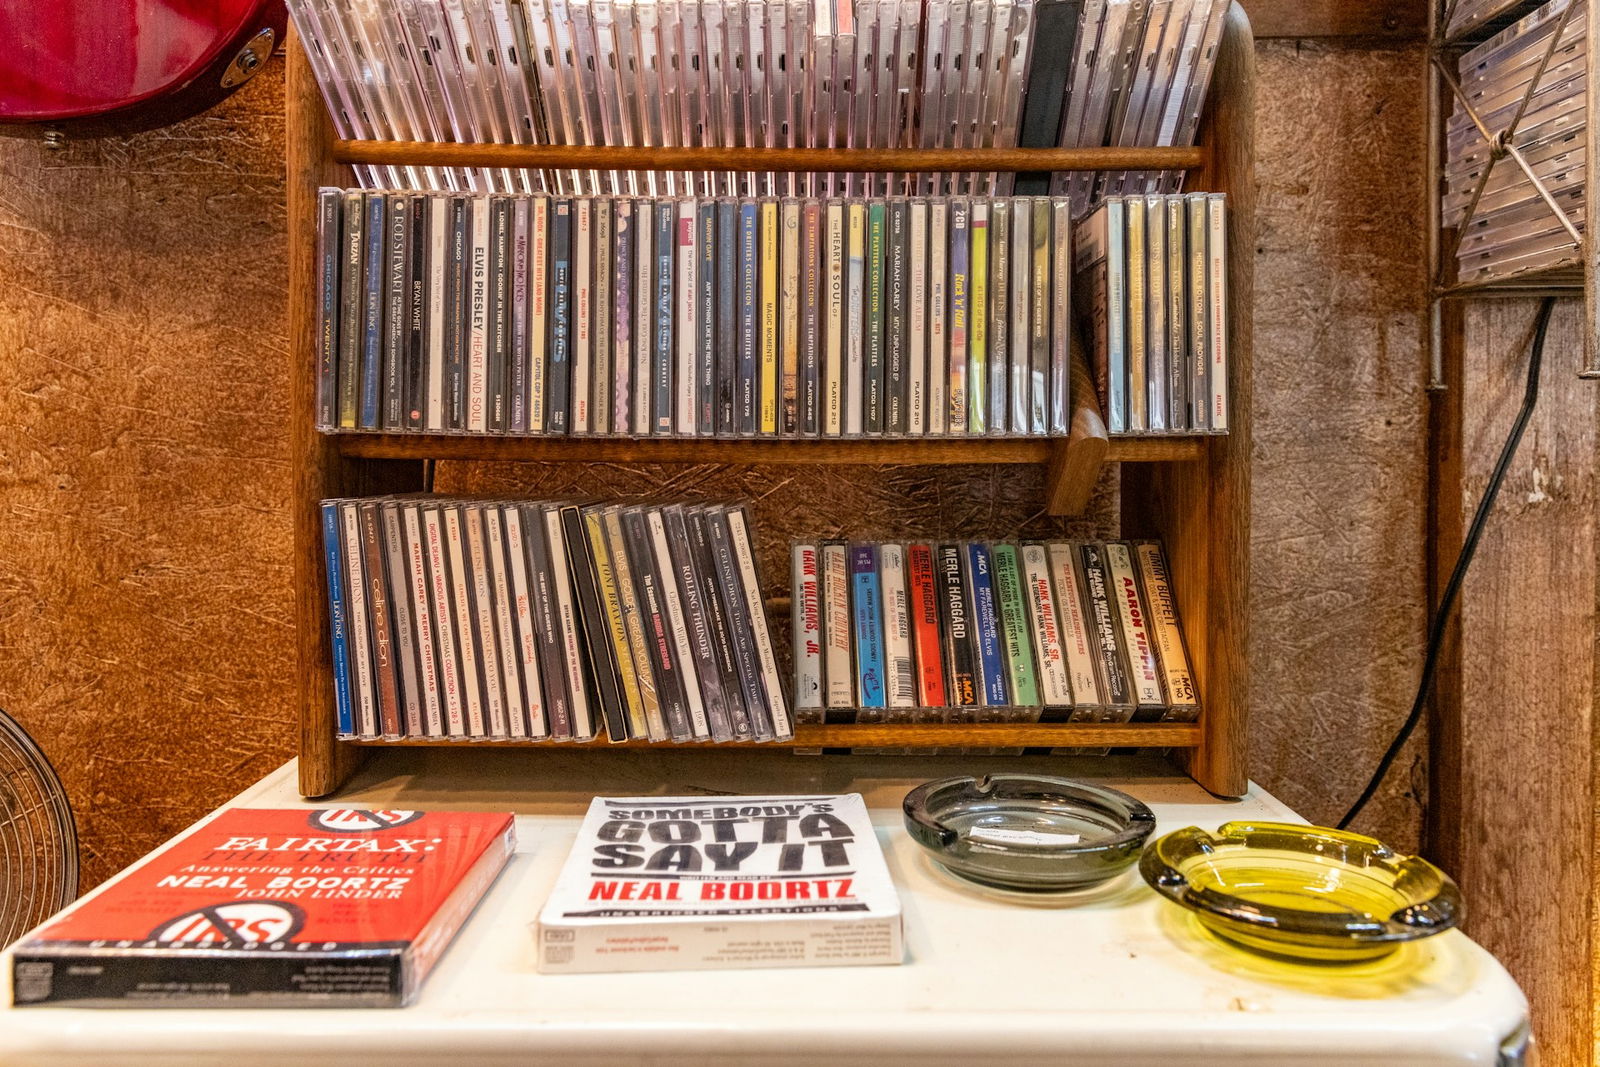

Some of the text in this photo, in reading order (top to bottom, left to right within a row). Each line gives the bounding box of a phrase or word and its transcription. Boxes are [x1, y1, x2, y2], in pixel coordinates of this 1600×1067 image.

[955, 210, 964, 228] 2CD
[350, 231, 360, 264] TARZAN
[393, 217, 404, 293] ROD STEWART
[413, 281, 421, 305] BRYAN
[832, 275, 840, 307] SOUL
[955, 274, 964, 295] Rock
[955, 310, 963, 328] Roll
[472, 247, 484, 424] ELVIS PRESLEY/HEART AND SOUL
[389, 516, 398, 552] CARPENTERS
[429, 523, 438, 545] DIGITAL
[349, 538, 359, 576] CELINE
[413, 543, 421, 575] MARIAH
[802, 550, 815, 575] HANK
[832, 552, 844, 574] HARD
[978, 555, 986, 575] MCA
[352, 577, 362, 604] DION
[416, 578, 425, 604] CAREY
[435, 575, 444, 600] VARIOUS
[644, 574, 652, 585] The
[719, 549, 737, 607] CELINE DION
[919, 550, 934, 624] MERLE HAGGARD
[979, 587, 985, 596] MY
[1149, 551, 1176, 627] JIMMY BUFFETT
[601, 563, 625, 642] TONI BRAXTON
[616, 551, 626, 570] ELVIS
[629, 617, 643, 648] GREATS
[804, 582, 818, 634] WILLIAMS,
[945, 549, 965, 638] MERLE HAGGARD
[997, 553, 1019, 657] MERLE HAGGARD GREATEST HITS
[1032, 584, 1042, 613] LEGENDARY
[373, 579, 388, 667] celine dion
[438, 602, 447, 623] ARTISTS
[682, 566, 710, 659] ROLLING THUNDER
[897, 590, 907, 638] MERLE HAGGARD
[980, 597, 989, 628] FAREWELL
[988, 608, 996, 638] HAGGARD
[1036, 614, 1044, 630] HANK
[1038, 579, 1059, 662] HANK WILLIAMS, SR.
[1093, 568, 1115, 651] HANK WILLIAMS
[441, 625, 450, 658] CHRISTMAS
[834, 611, 848, 652] COUNTRY
[983, 629, 989, 637] TO
[1123, 577, 1154, 681] AARON TIPPIN
[806, 641, 819, 658] JR.
[1038, 631, 1049, 659] WILLIAMS,
[424, 645, 435, 692] CHRISTMAS
[445, 659, 454, 694] COLLECTION
[963, 680, 973, 704] MCA
[1182, 678, 1193, 700] MCA
[450, 701, 458, 724] 5-128-2
[609, 803, 834, 819] SOMEBODY'S
[597, 814, 854, 843] GOTTA
[216, 836, 442, 852] FAIRTAX:
[298, 851, 427, 864] TRUTH
[592, 838, 854, 872] SAY IT
[157, 876, 410, 890] NEAL BOORTZ
[181, 865, 414, 875] Answering the Critics
[236, 889, 401, 900] JOHN LINDER
[588, 879, 857, 901] NEAL BOORTZ
